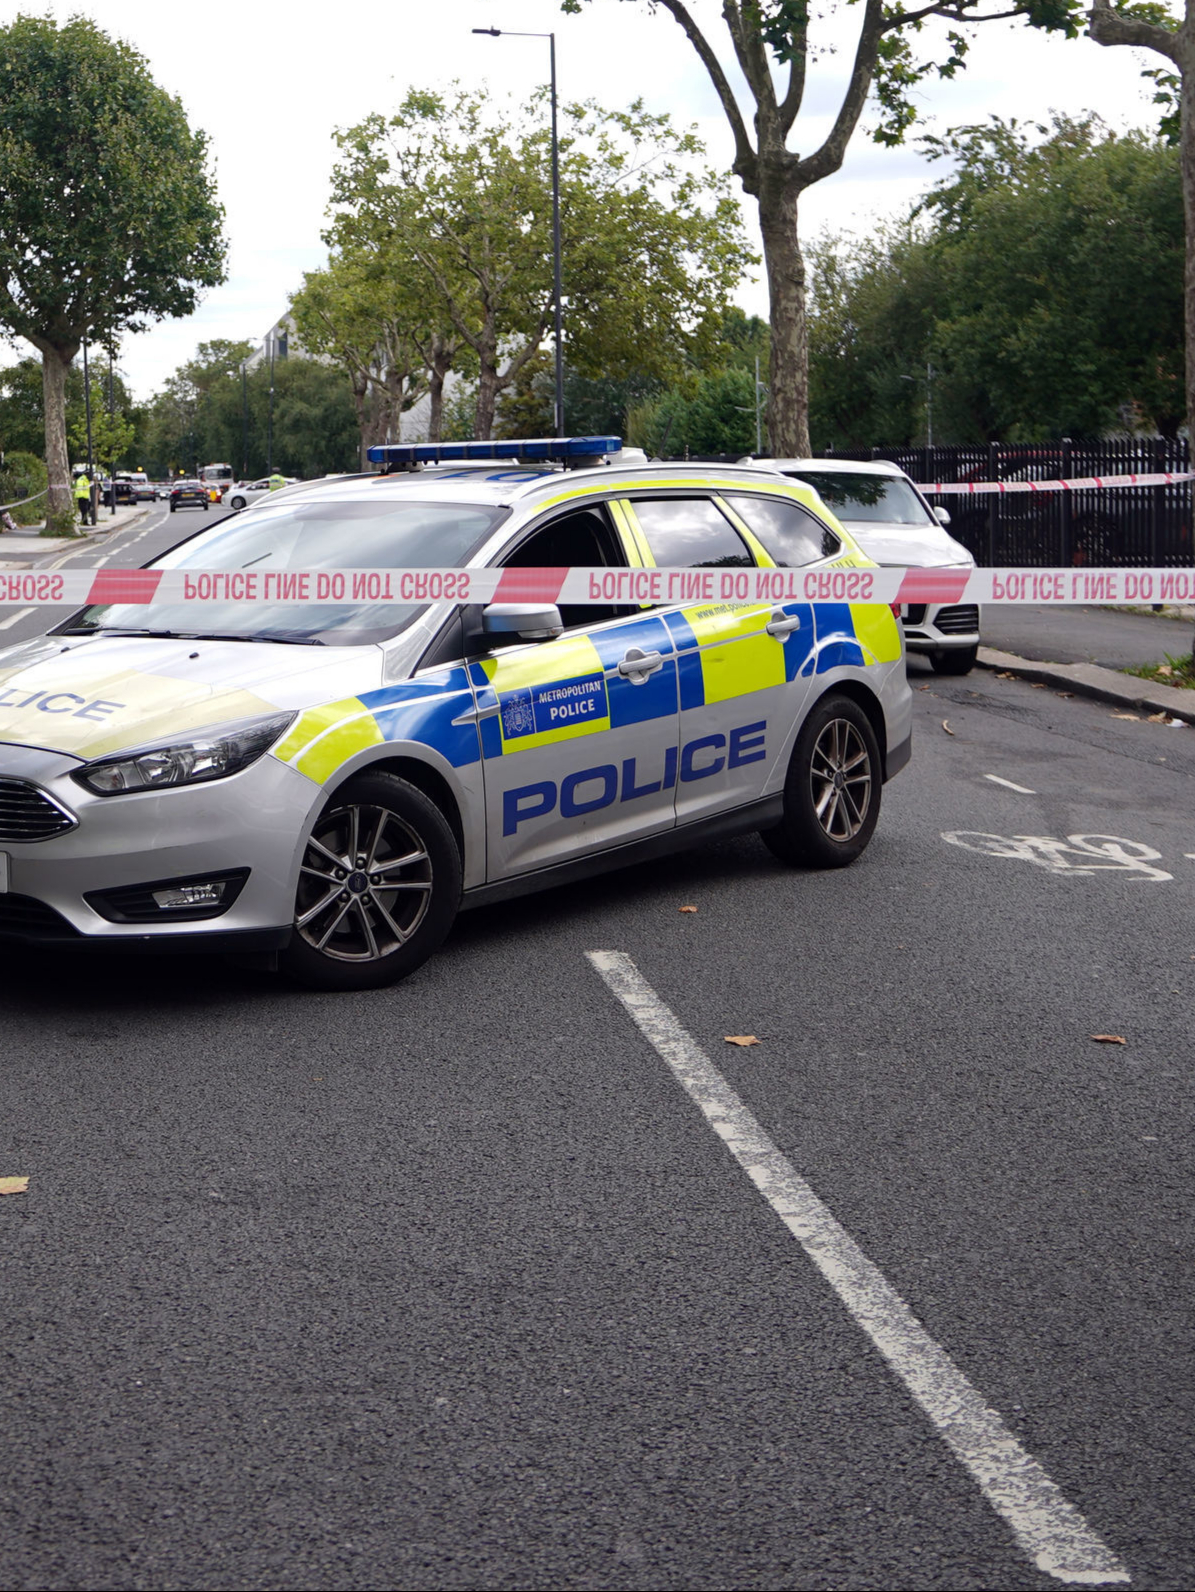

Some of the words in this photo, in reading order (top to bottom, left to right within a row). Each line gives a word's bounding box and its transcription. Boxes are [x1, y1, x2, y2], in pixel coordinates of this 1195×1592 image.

[538, 680, 601, 703] METROPOLITAN
[550, 698, 595, 720] POLICE
[502, 720, 766, 837] POLICE
